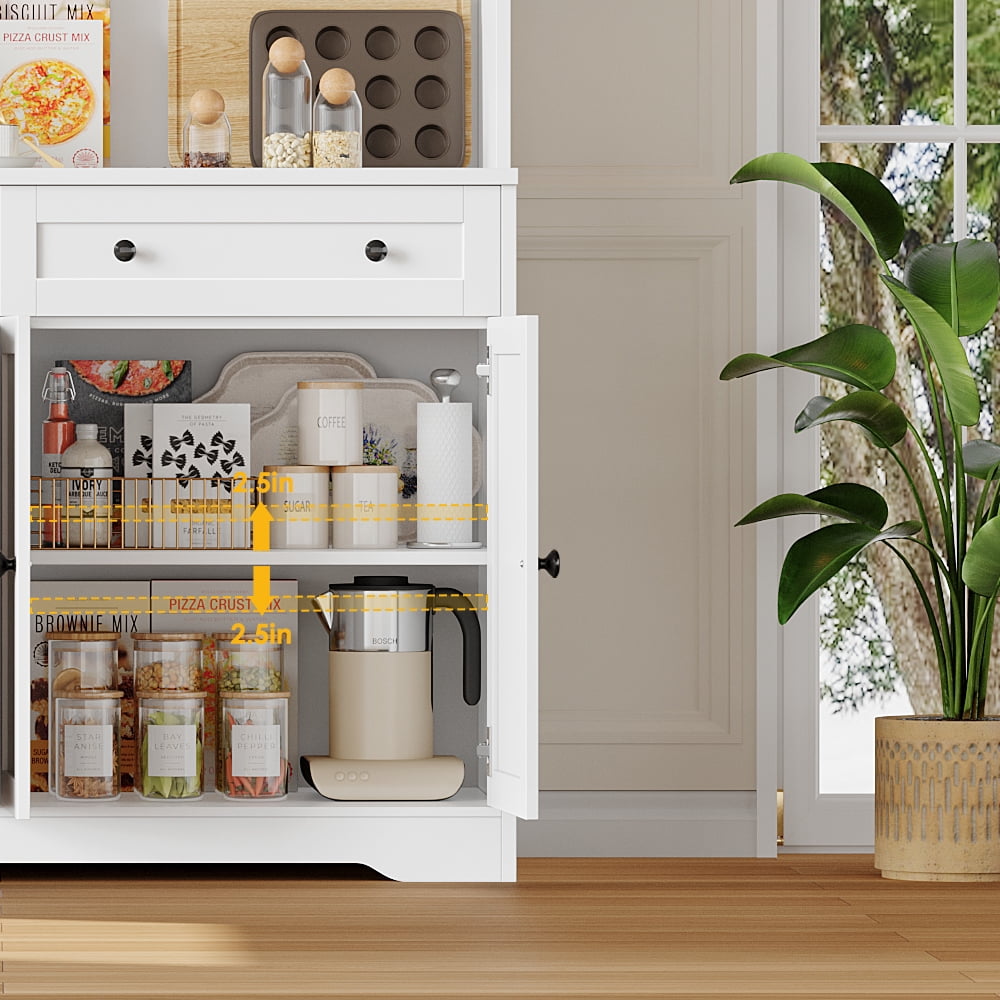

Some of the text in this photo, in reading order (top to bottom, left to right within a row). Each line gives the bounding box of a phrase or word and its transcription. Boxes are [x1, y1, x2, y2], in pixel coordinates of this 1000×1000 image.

[67, 3, 94, 20] MIX
[3, 32, 90, 42] PIZZA CRUST MIX
[316, 416, 347, 429] COFFEE
[283, 500, 311, 513] SUGAR
[359, 500, 374, 513] TEA
[168, 598, 206, 610] PIZZA
[209, 598, 251, 610] CRUST
[35, 614, 138, 633] BROWNIE MIX
[372, 637, 398, 645] BOSCH
[162, 733, 183, 741] BAY
